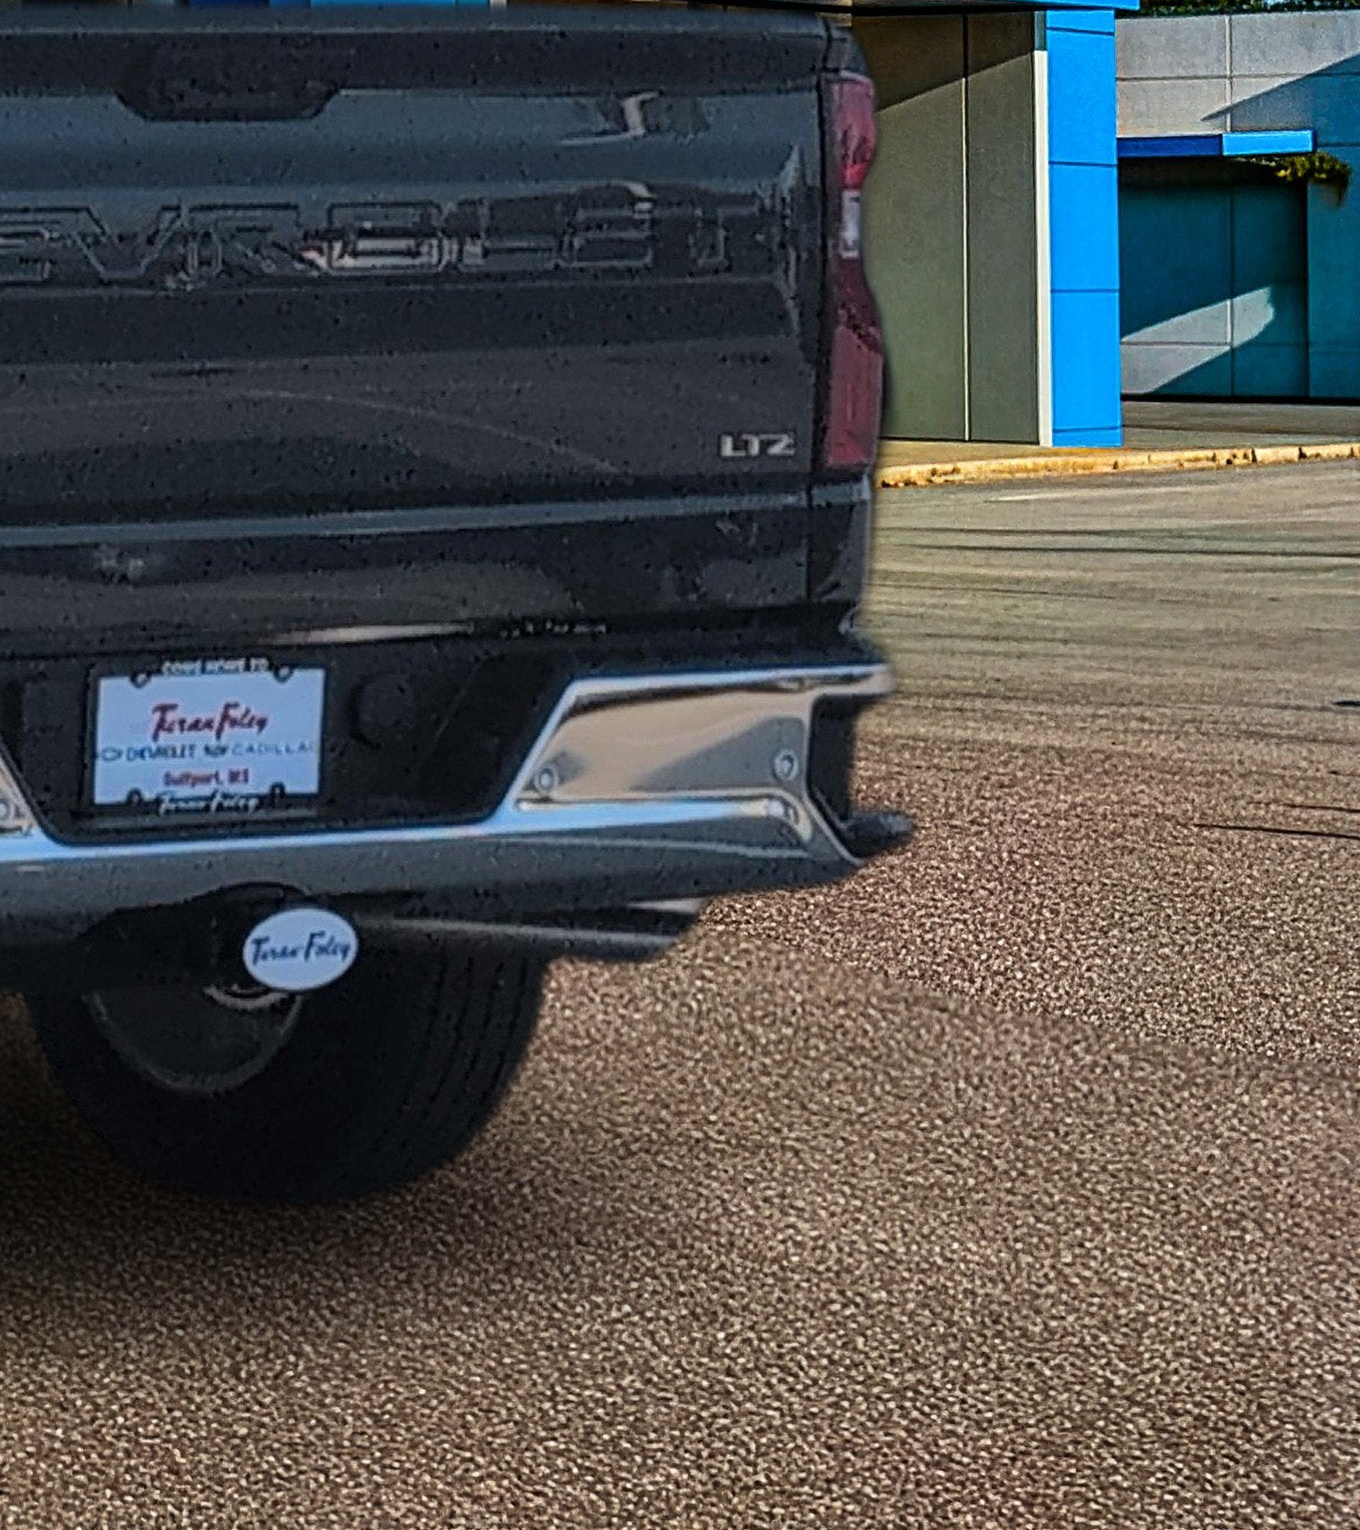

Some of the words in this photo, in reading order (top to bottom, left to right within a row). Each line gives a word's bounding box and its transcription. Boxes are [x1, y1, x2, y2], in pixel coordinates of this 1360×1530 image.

[720, 433, 795, 457] LTZ
[215, 700, 268, 741] Foley
[303, 930, 351, 963] Foley
